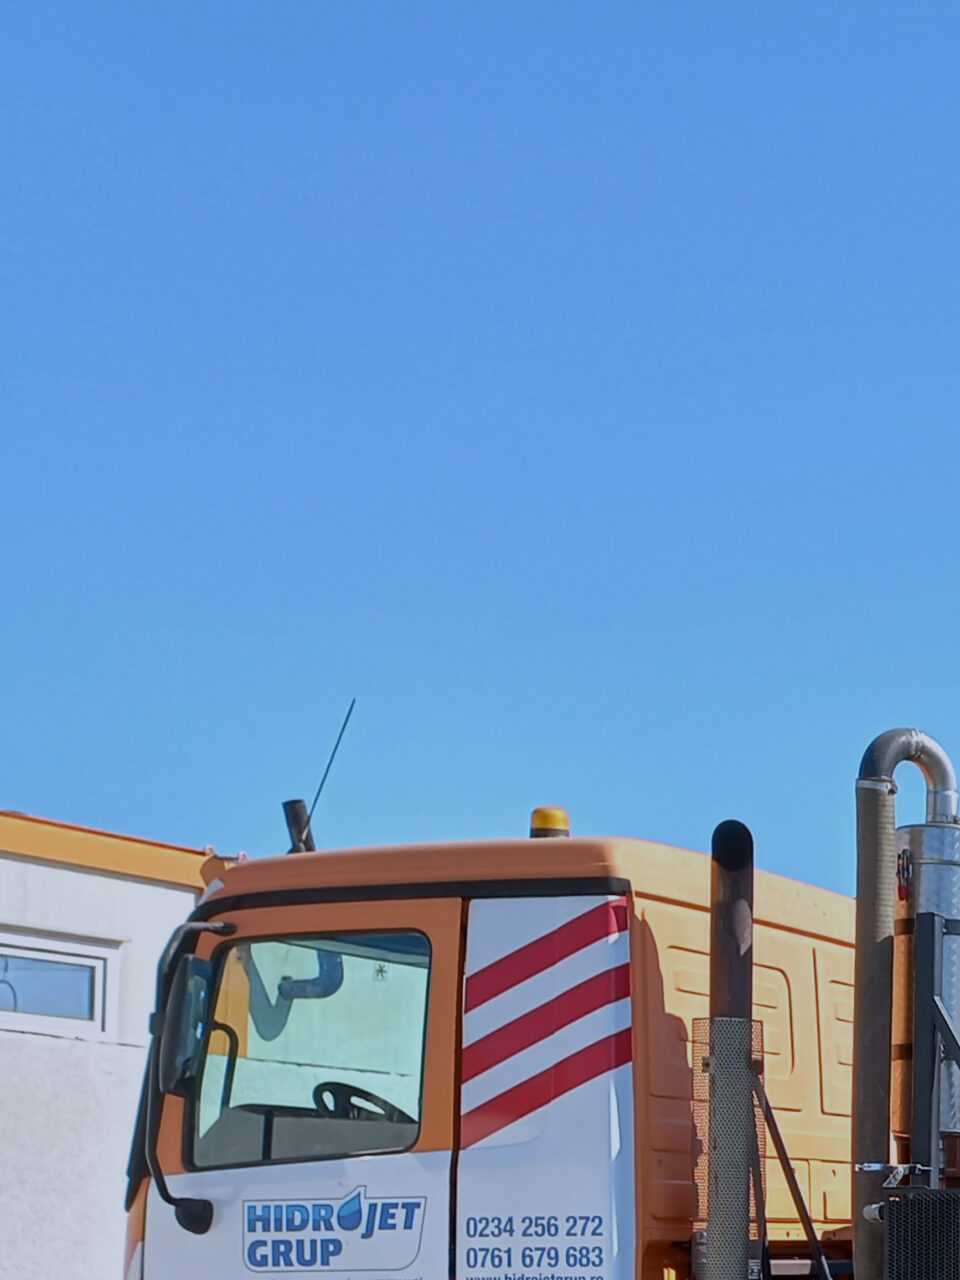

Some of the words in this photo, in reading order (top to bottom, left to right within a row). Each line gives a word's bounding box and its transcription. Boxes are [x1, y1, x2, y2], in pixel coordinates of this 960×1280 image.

[466, 1216, 515, 1238] 0234
[521, 1215, 559, 1237] 256
[565, 1215, 603, 1237] 272
[247, 1238, 343, 1267] GRUP
[466, 1247, 512, 1268] 0761
[521, 1247, 559, 1268] 679
[565, 1246, 604, 1268] 683
